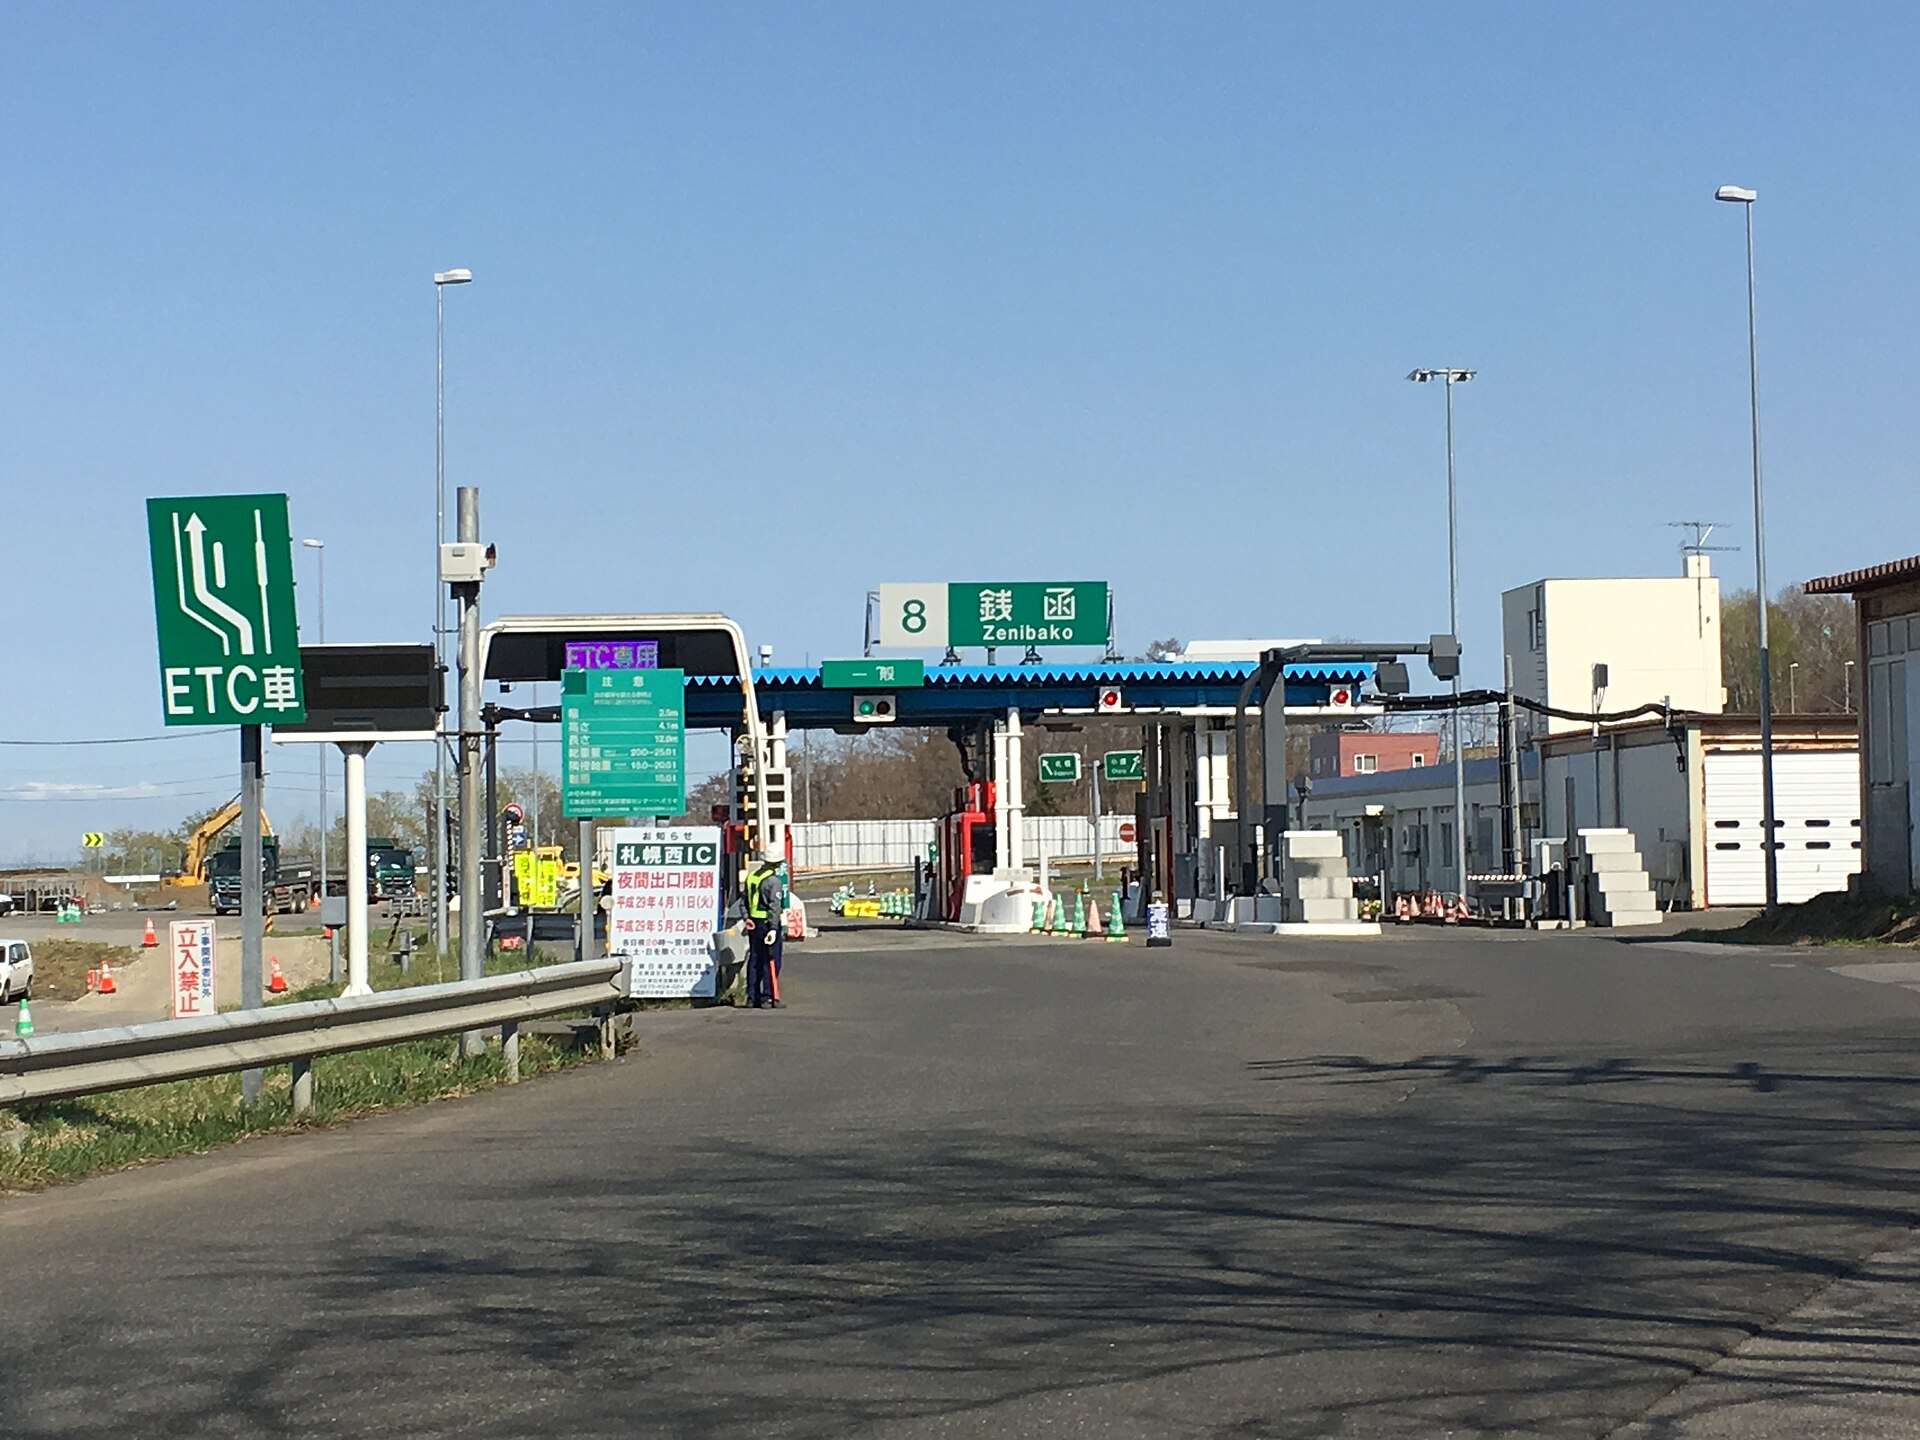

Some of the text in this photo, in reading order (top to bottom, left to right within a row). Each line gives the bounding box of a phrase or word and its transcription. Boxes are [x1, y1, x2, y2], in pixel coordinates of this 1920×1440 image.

[902, 599, 926, 633] 8
[983, 625, 1073, 641] Zenibako
[165, 664, 300, 714] ETC車
[642, 832, 693, 840] お知らせ
[620, 845, 712, 864] 札幌西IC
[617, 871, 714, 889] 夜間出口閉鎖
[178, 927, 200, 1013] 立入禁止
